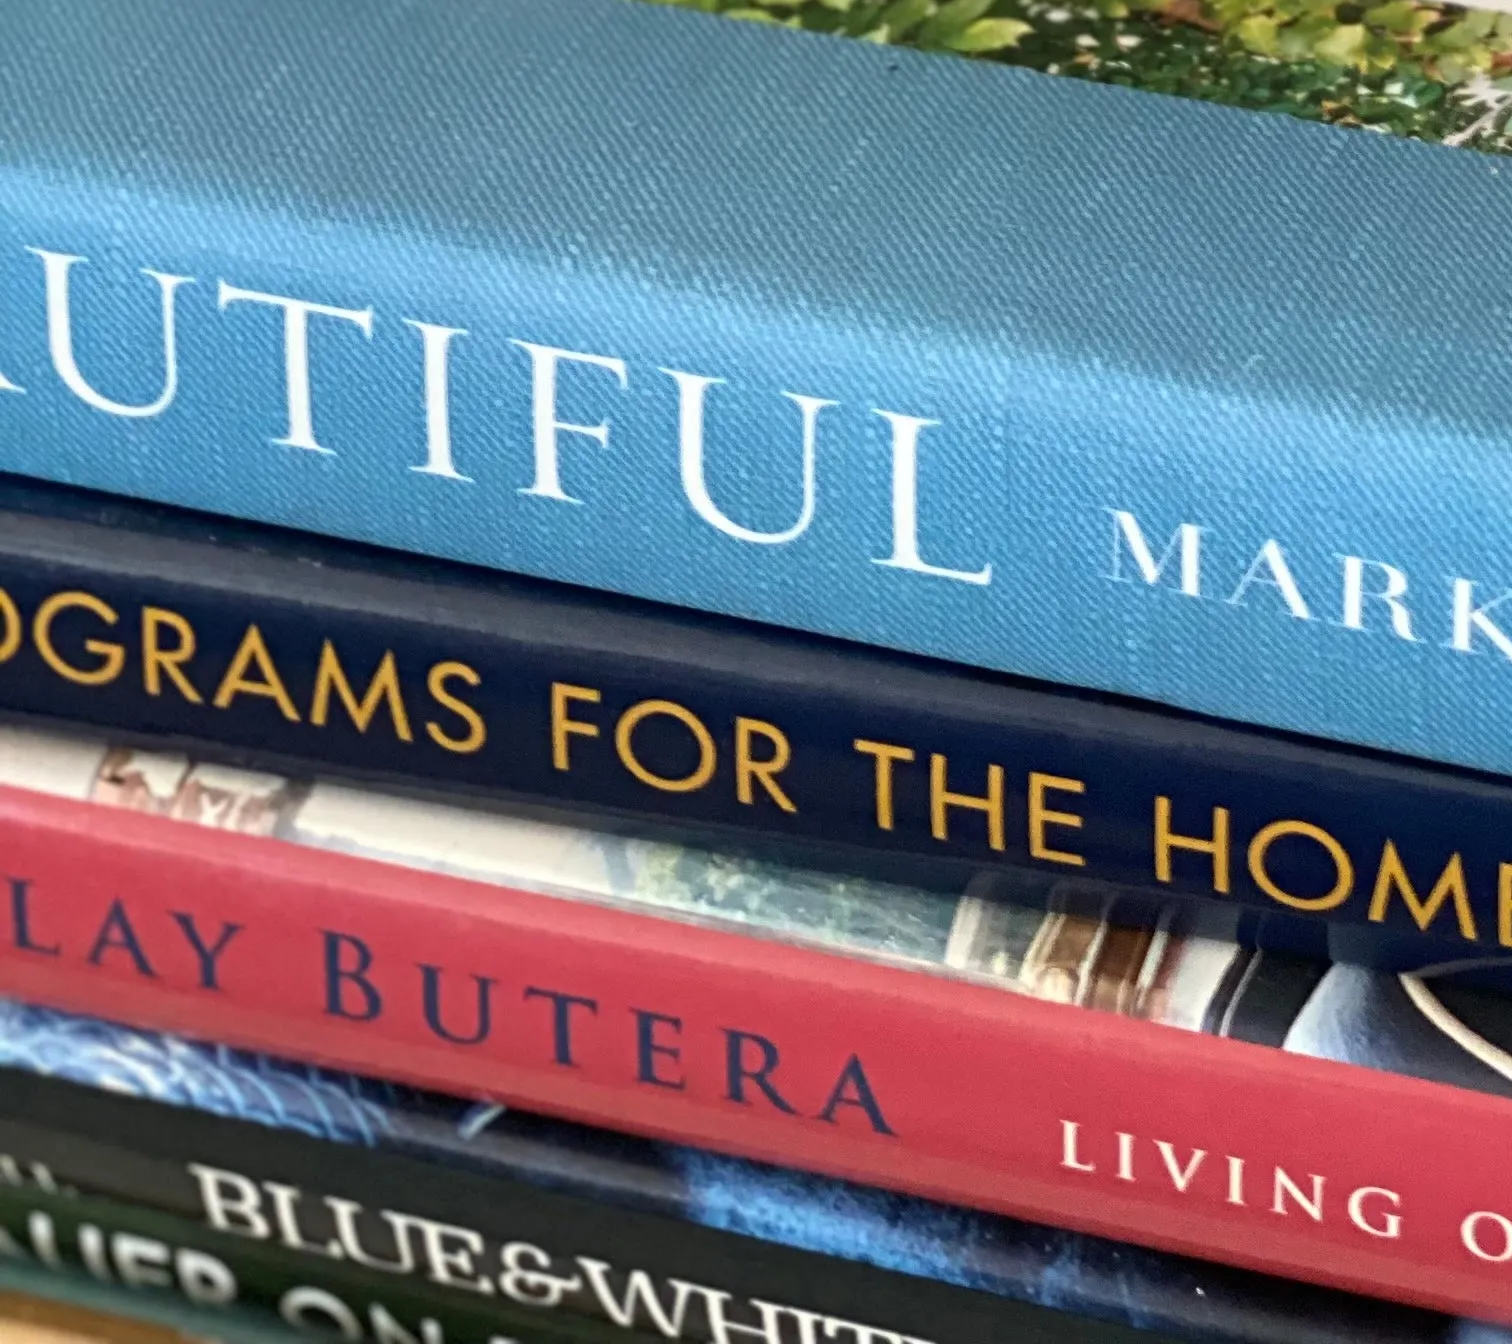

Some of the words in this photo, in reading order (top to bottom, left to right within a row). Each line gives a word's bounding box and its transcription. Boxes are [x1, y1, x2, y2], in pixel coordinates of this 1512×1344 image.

[0, 245, 992, 586] UTIFUL
[0, 586, 487, 754] GRAMS
[551, 683, 796, 812] FOR
[854, 739, 1085, 867] THE
[6, 876, 244, 992] LAY
[319, 929, 898, 1137] BUTERA
[1061, 1120, 1404, 1238] LIVING
